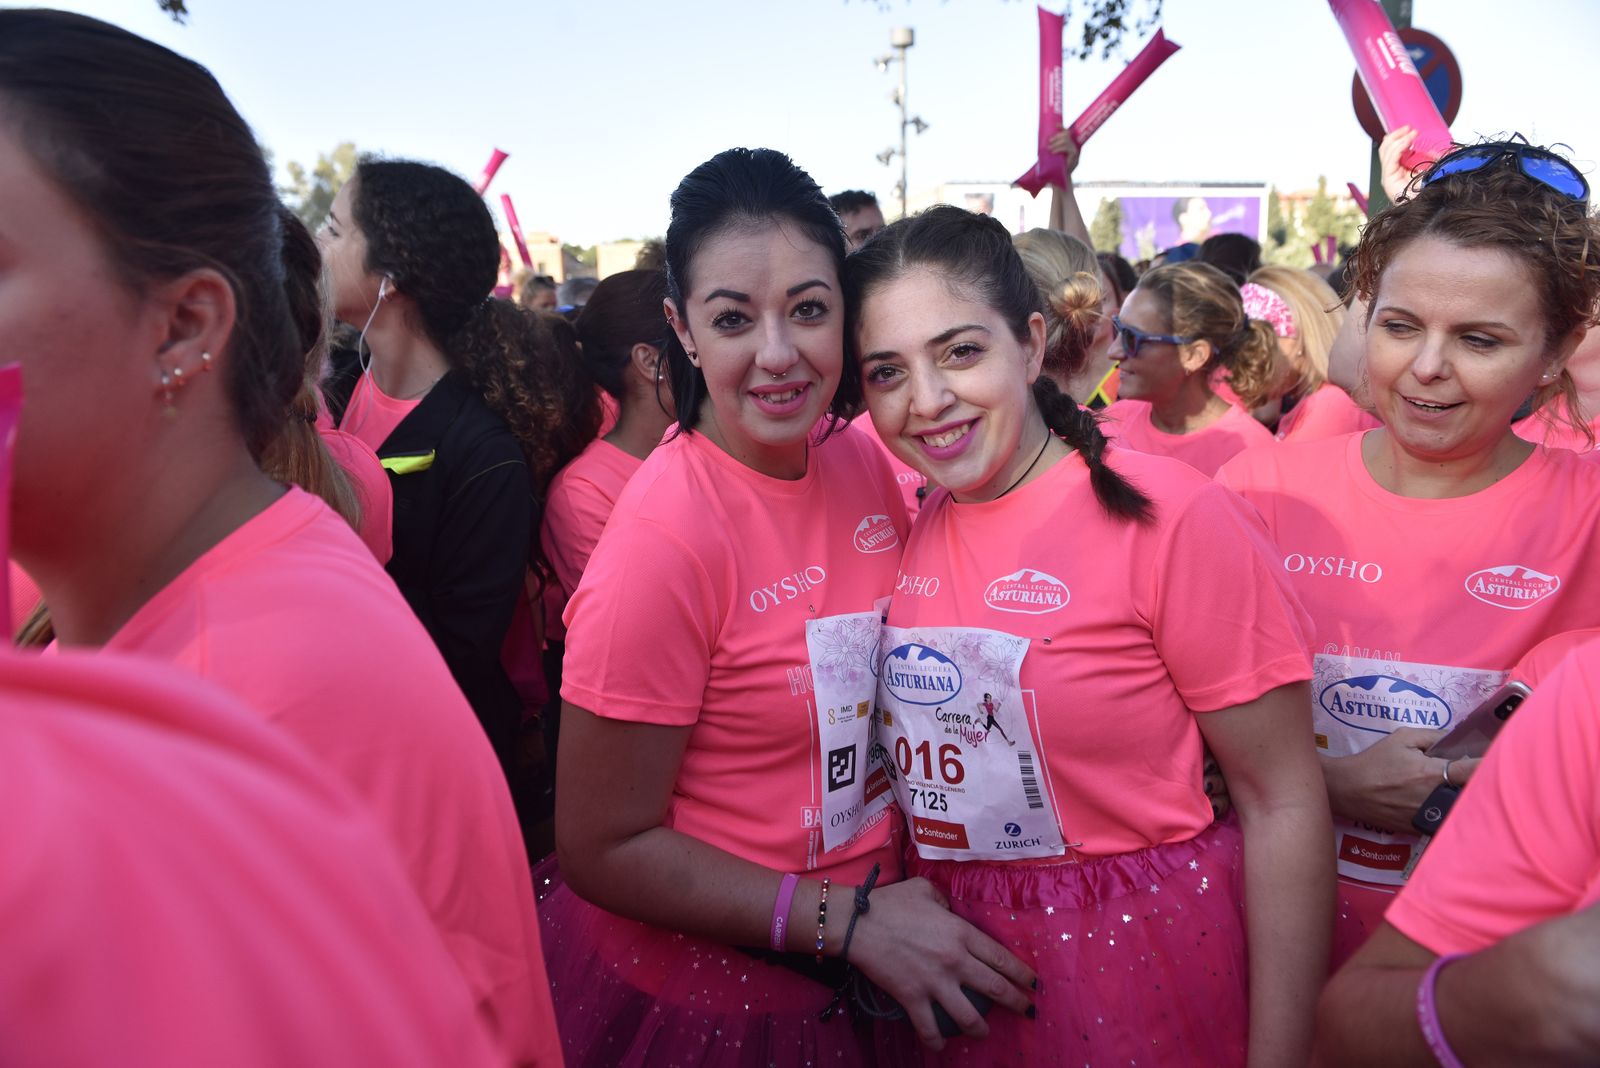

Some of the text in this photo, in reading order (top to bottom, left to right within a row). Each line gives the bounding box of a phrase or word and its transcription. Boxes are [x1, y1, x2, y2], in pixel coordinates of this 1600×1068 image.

[1284, 553, 1382, 583] OYSHO
[750, 565, 826, 612] OYSHO
[989, 585, 1062, 606] ASTURIANA
[887, 663, 955, 692] ASTURIANA
[1330, 691, 1440, 726] ASTURIANA
[1346, 691, 1387, 703] CENTRAL
[935, 707, 972, 725] Carrera
[945, 723, 989, 748] de la Mujer
[895, 736, 965, 785] 016
[909, 788, 948, 812] 7125
[924, 827, 958, 840] Santander
[995, 838, 1041, 850] ZURICH
[1360, 849, 1401, 861] Santander
